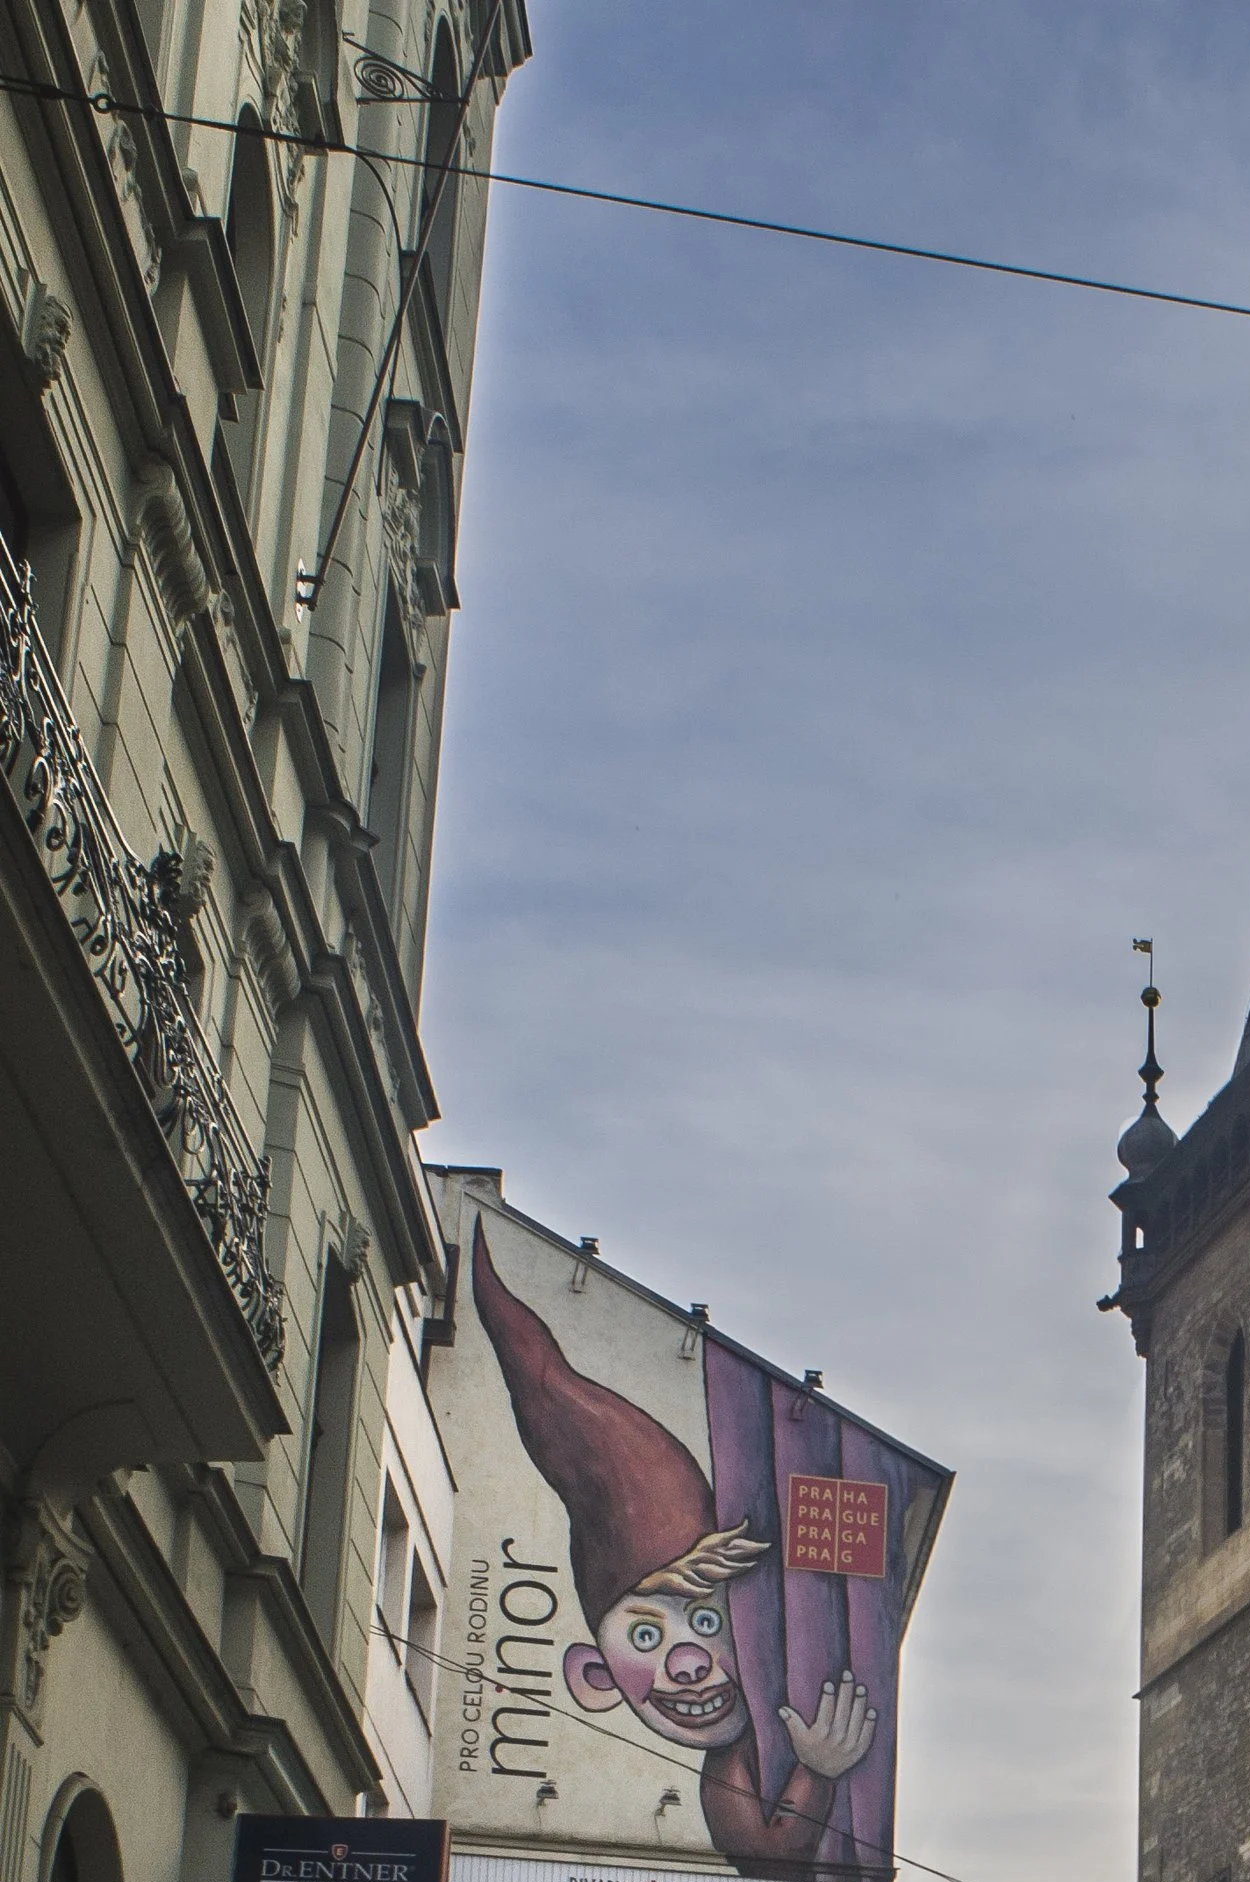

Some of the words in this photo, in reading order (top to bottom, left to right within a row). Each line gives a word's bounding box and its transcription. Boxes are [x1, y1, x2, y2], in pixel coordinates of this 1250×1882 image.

[799, 1485, 833, 1501] PRA
[843, 1490, 868, 1505] HA
[798, 1505, 832, 1520] PRA
[842, 1510, 880, 1526] GUE
[797, 1525, 832, 1541] PRA
[841, 1530, 867, 1545] GA
[796, 1545, 831, 1560] PRA
[841, 1550, 853, 1563] G
[467, 1559, 490, 1643] RODINU
[489, 1537, 559, 1779] minor
[463, 1652, 485, 1723] CELOU
[459, 1728, 480, 1772] PRO
